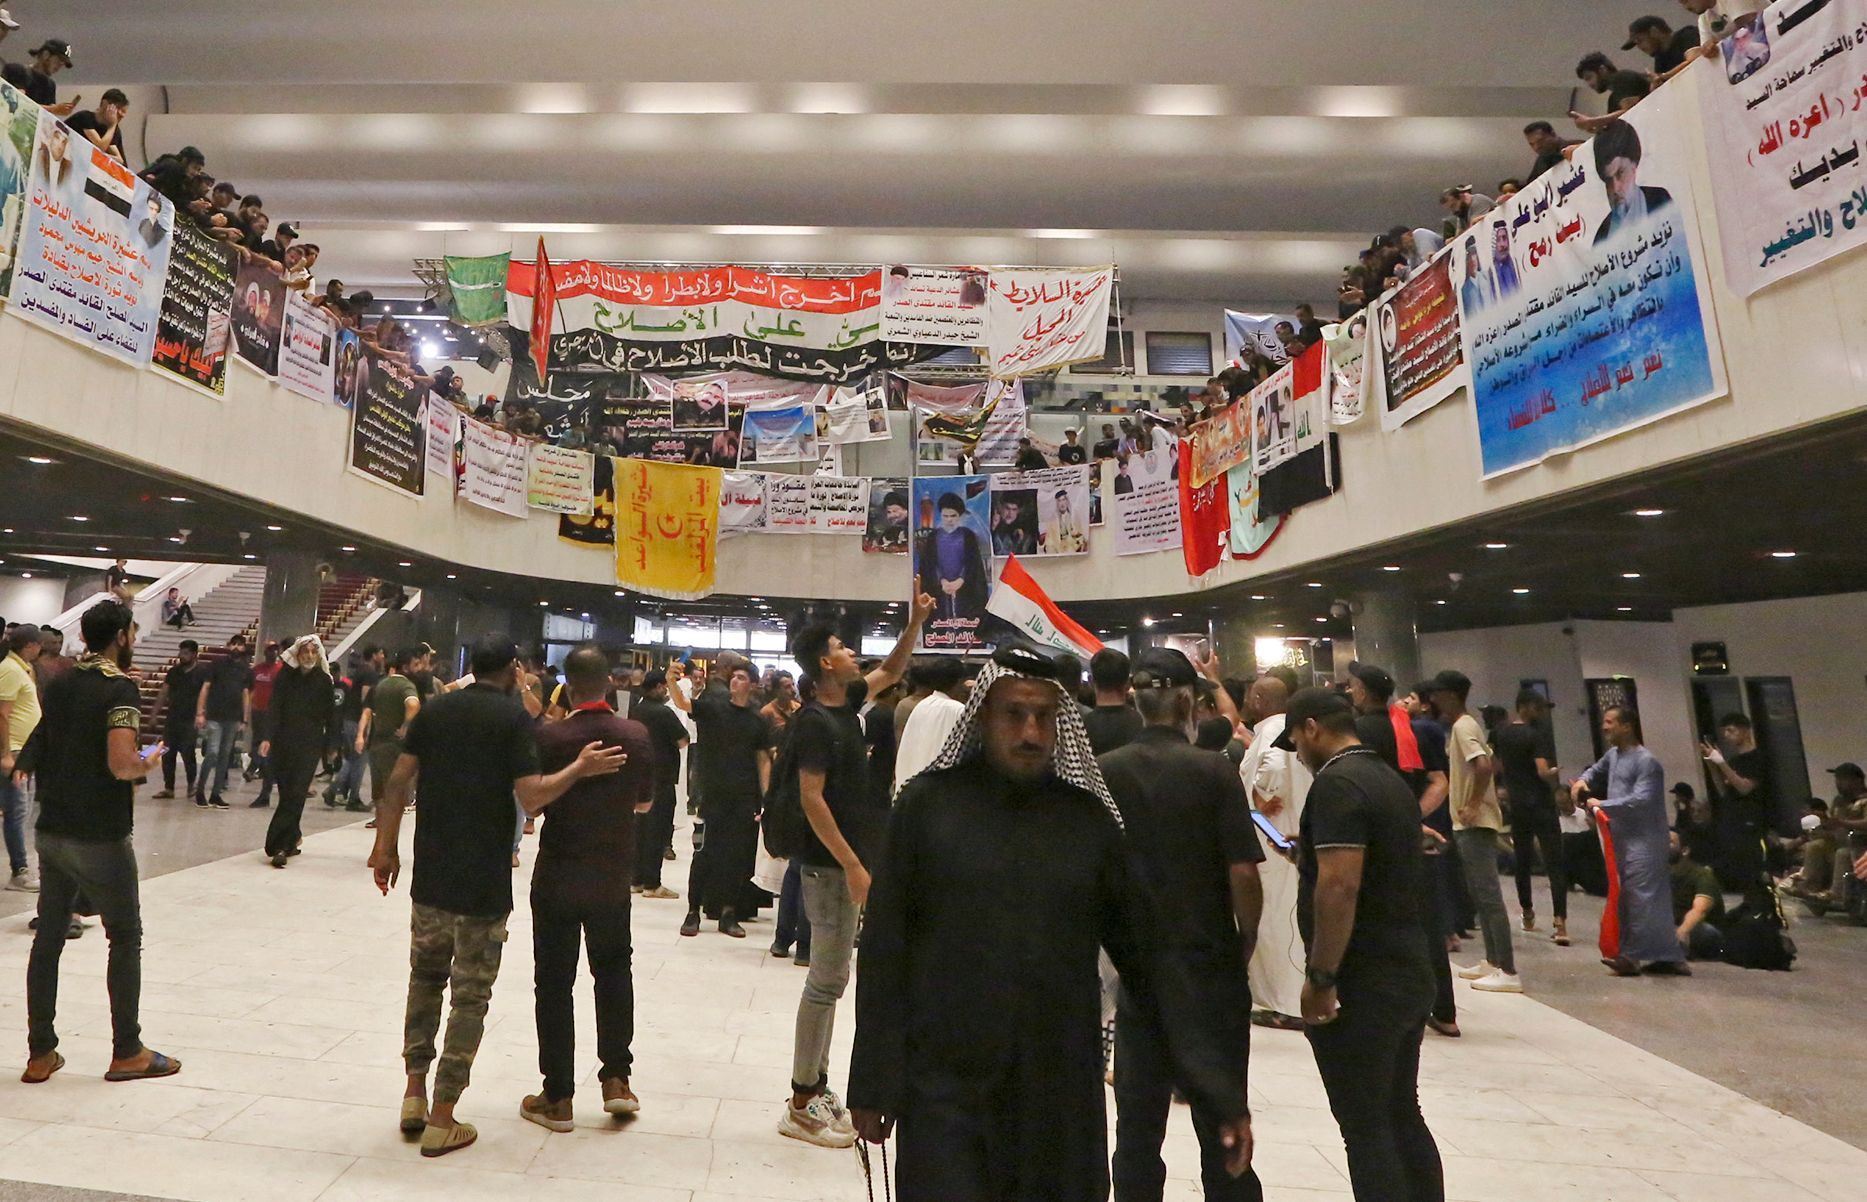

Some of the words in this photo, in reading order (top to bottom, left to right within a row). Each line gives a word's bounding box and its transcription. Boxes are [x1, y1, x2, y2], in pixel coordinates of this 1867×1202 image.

[1775, 66, 1805, 91] سماحة
[1760, 207, 1833, 267] والتغيير
[1621, 234, 1648, 270] مشروع
[942, 331, 958, 340] حيدر
[960, 330, 979, 340] الشيخ
[778, 348, 877, 382] خرجت
